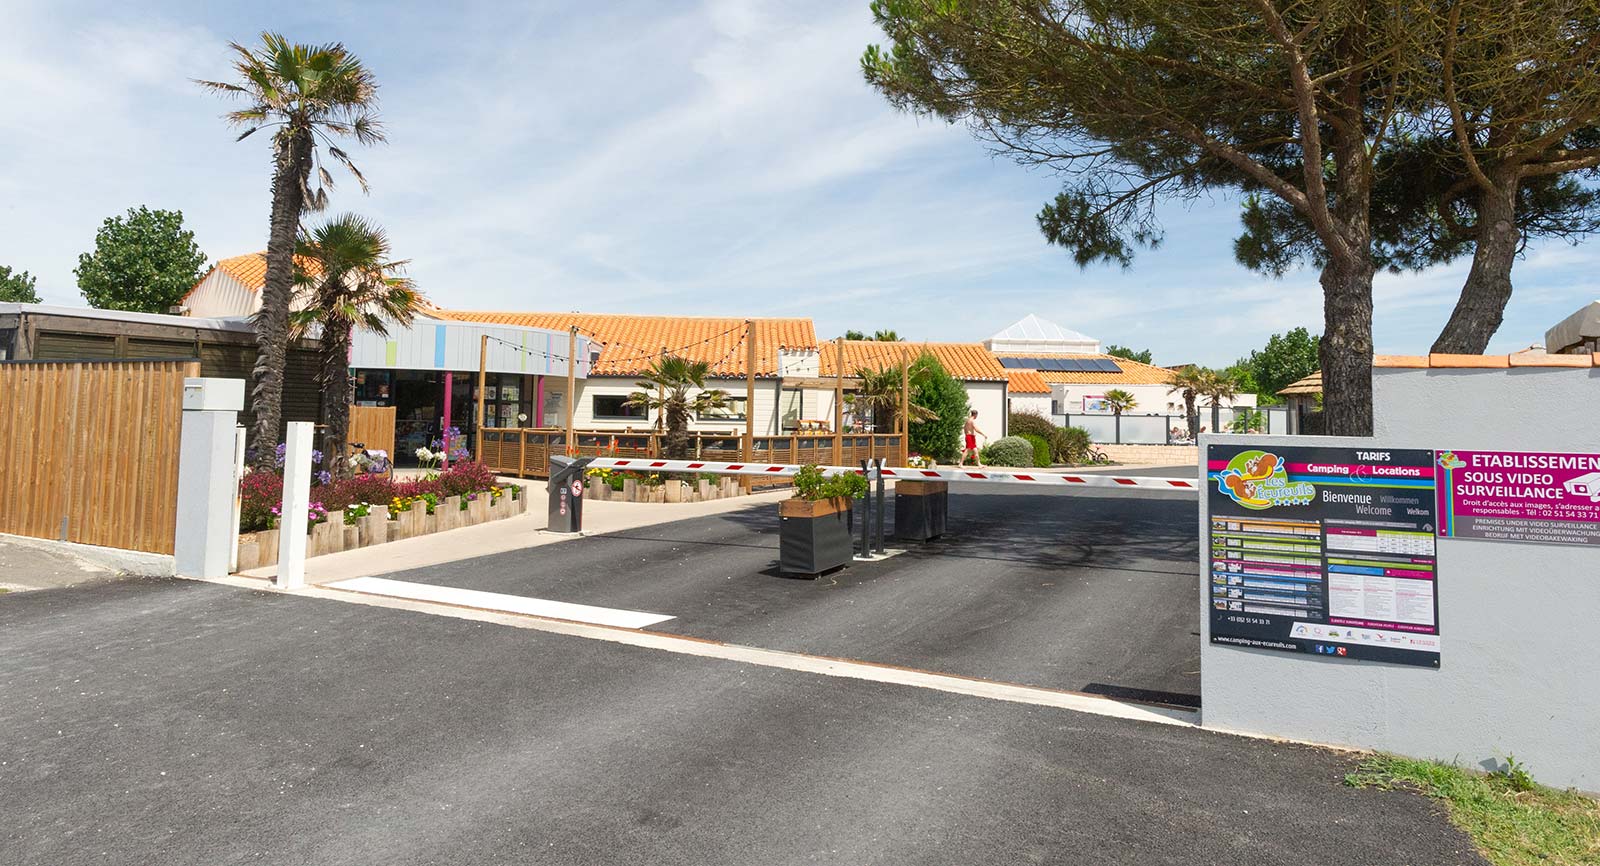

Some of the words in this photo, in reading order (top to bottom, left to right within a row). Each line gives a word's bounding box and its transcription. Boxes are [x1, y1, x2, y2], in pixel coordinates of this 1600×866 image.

[1356, 452, 1390, 461] TARIFS
[1307, 464, 1349, 474] Camping
[1372, 466, 1420, 476] Locations
[1265, 477, 1285, 487] Les
[1464, 472, 1503, 483] SOUS
[1506, 473, 1553, 485] VIDEO
[1257, 484, 1314, 499] Écureuils
[1322, 490, 1372, 504] Bienvenue
[1380, 495, 1419, 504] Willkommen
[1456, 484, 1564, 499] SURVEILLANCE
[1356, 504, 1392, 515] Welcome
[1550, 522, 1597, 530] SURVEILLANCE
